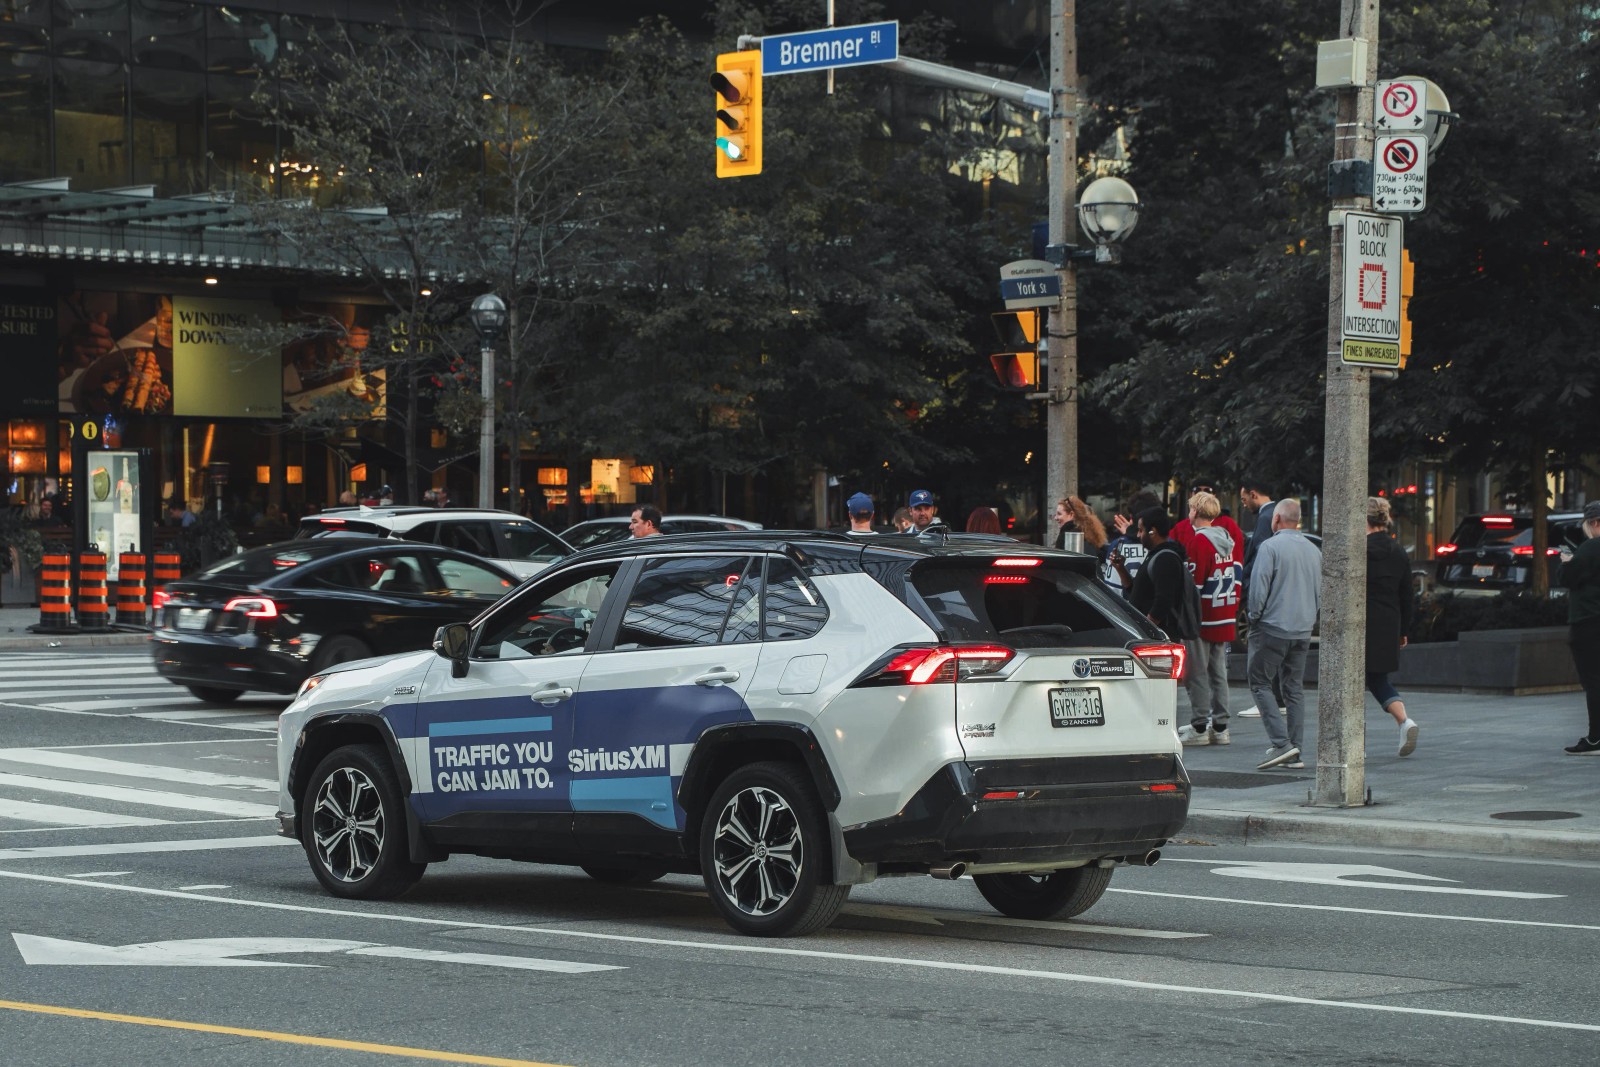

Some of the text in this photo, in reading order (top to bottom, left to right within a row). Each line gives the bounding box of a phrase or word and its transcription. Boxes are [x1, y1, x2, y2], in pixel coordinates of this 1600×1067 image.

[781, 30, 881, 66] Bremner Bl
[1357, 219, 1390, 238] DO NOT
[1360, 239, 1387, 258] BLOCK
[1017, 281, 1037, 295] York
[0, 320, 38, 336] SURE
[179, 311, 248, 327] WINDING
[1345, 315, 1398, 336] INTERSECTION
[179, 329, 227, 345] DOWN
[1345, 344, 1397, 361] FINES INCREASED
[1212, 566, 1236, 608] 22
[1054, 697, 1101, 717] GVRY 316
[964, 731, 995, 739] PRIME
[434, 741, 553, 768] TRAFFIC YOU
[568, 745, 666, 773] SiriusXM
[437, 767, 554, 793] CAN JAM TO.
